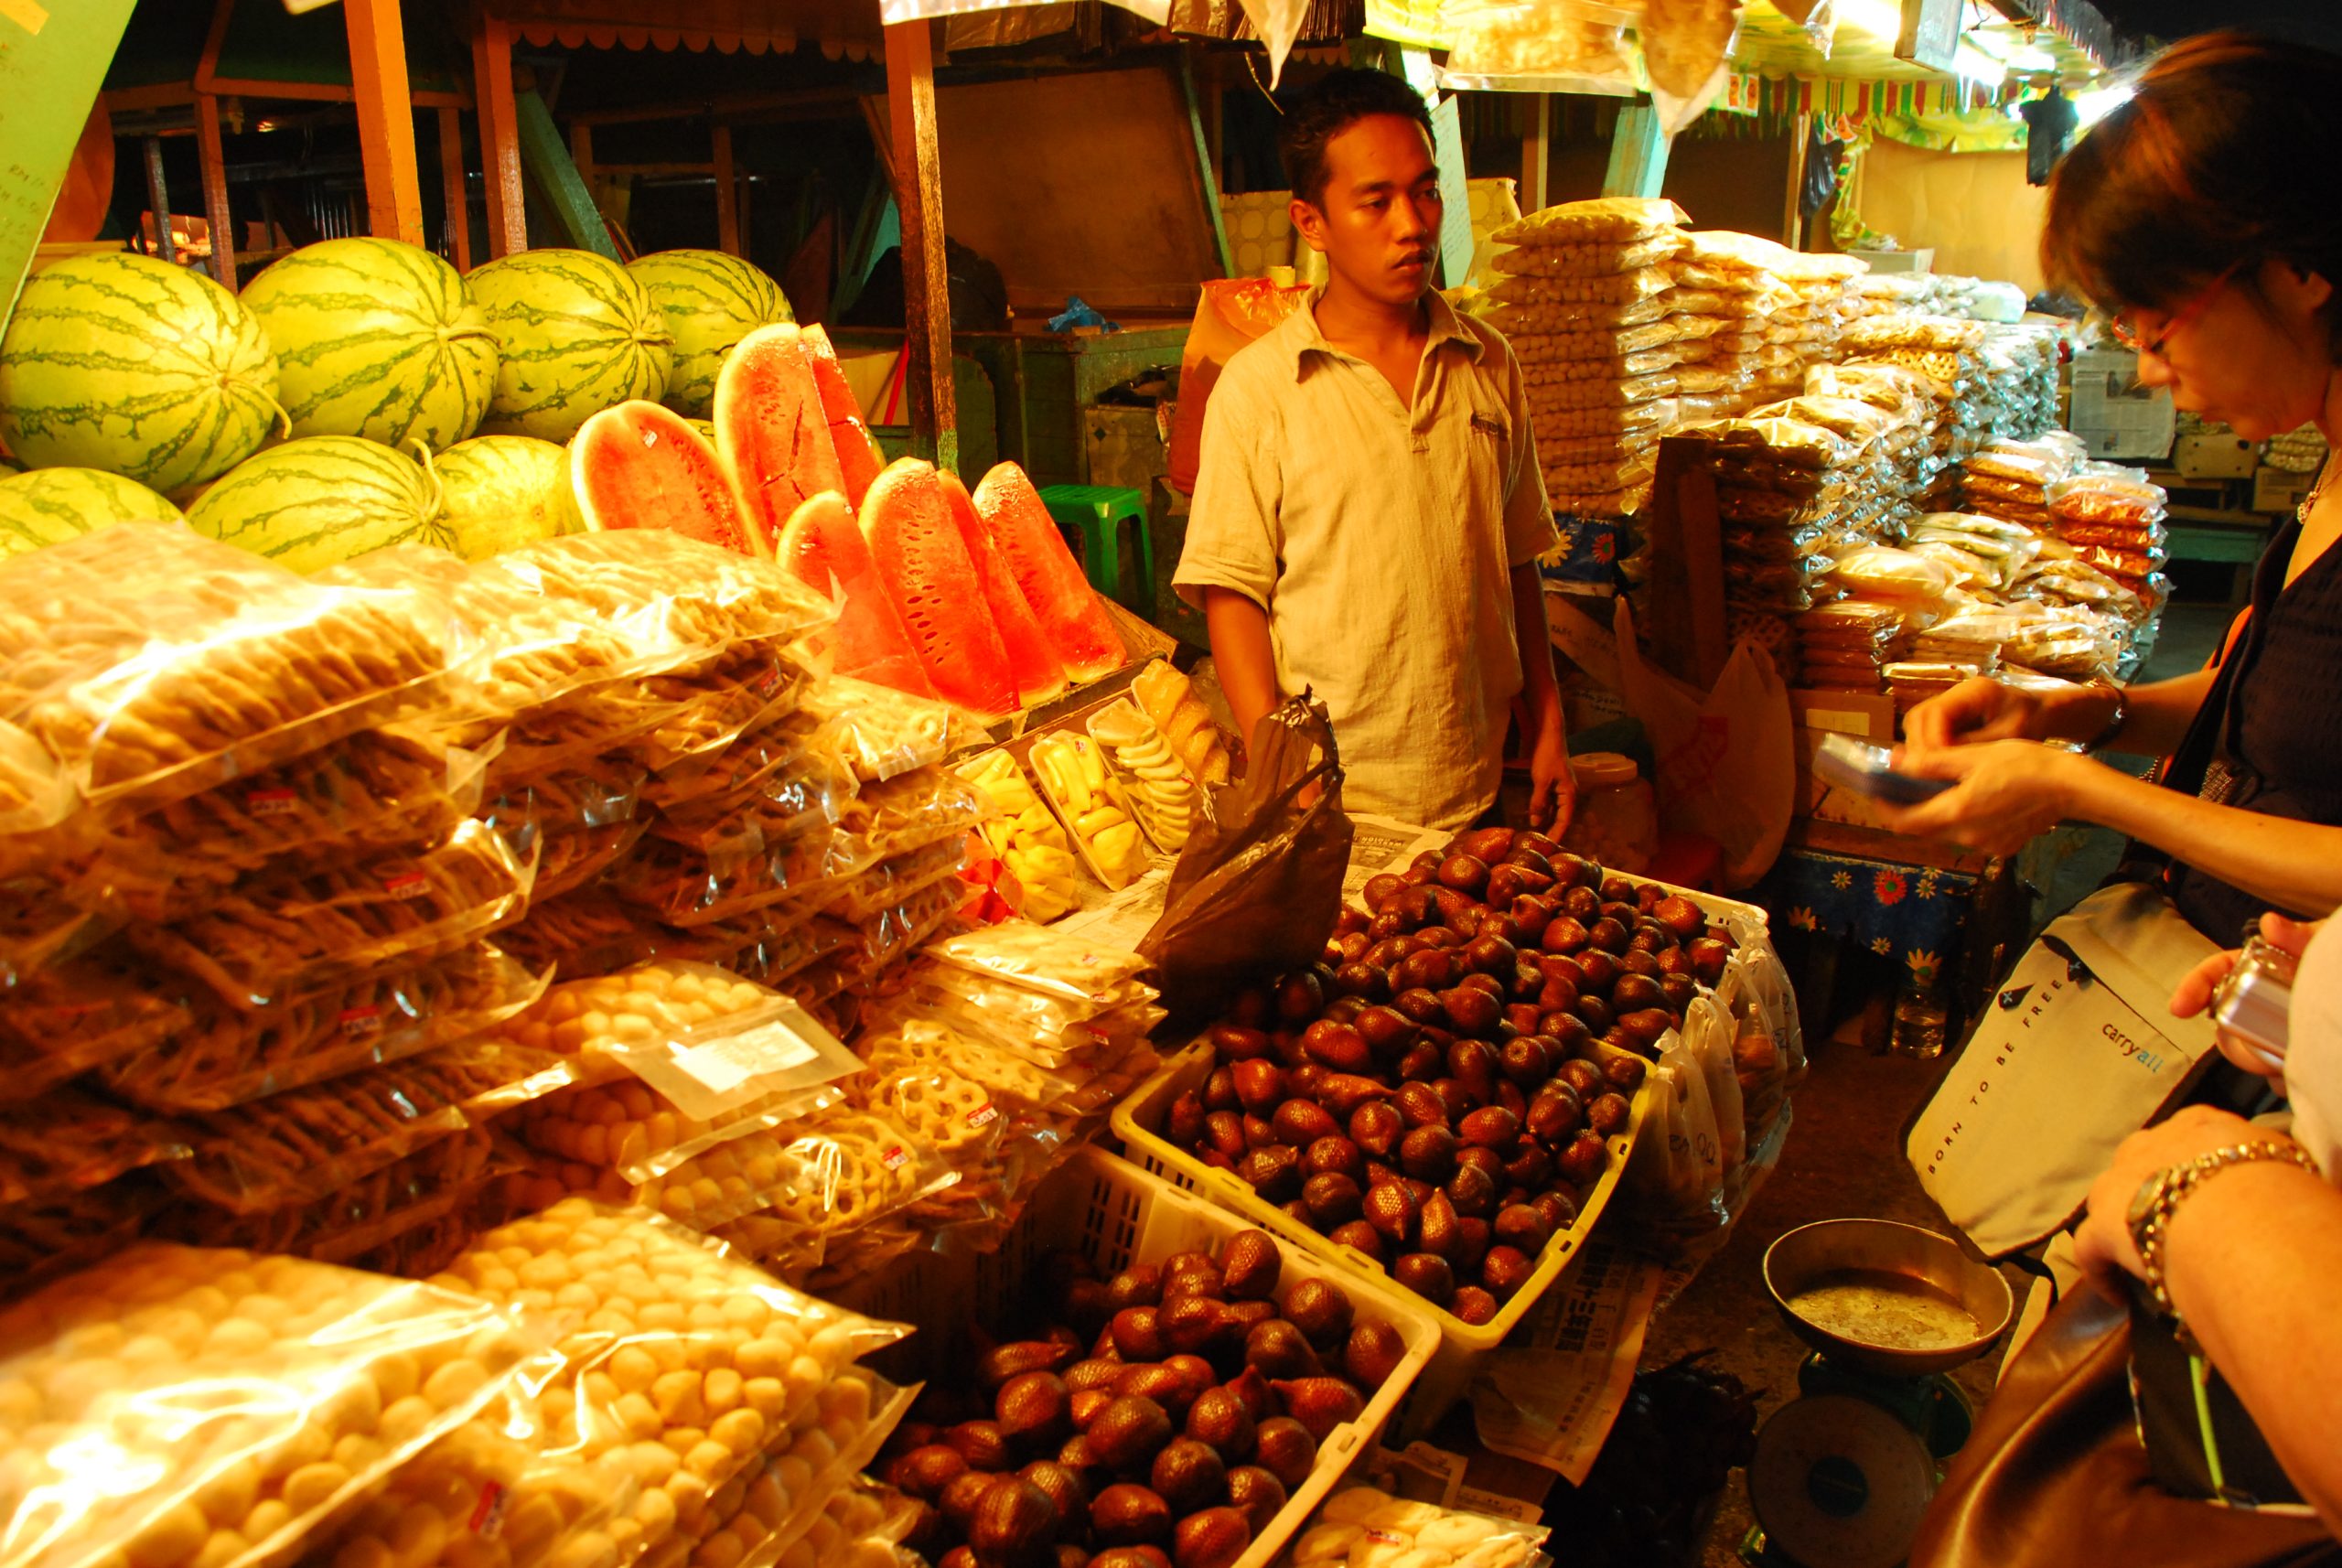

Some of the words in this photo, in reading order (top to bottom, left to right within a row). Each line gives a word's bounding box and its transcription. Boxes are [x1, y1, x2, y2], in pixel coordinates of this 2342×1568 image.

[1928, 1122, 1962, 1174] BORN
[1970, 1081, 1988, 1105] TO
[1997, 1043, 2014, 1066] BE
[2024, 980, 2062, 1028] FREE
[2102, 1023, 2164, 1073] carryall
